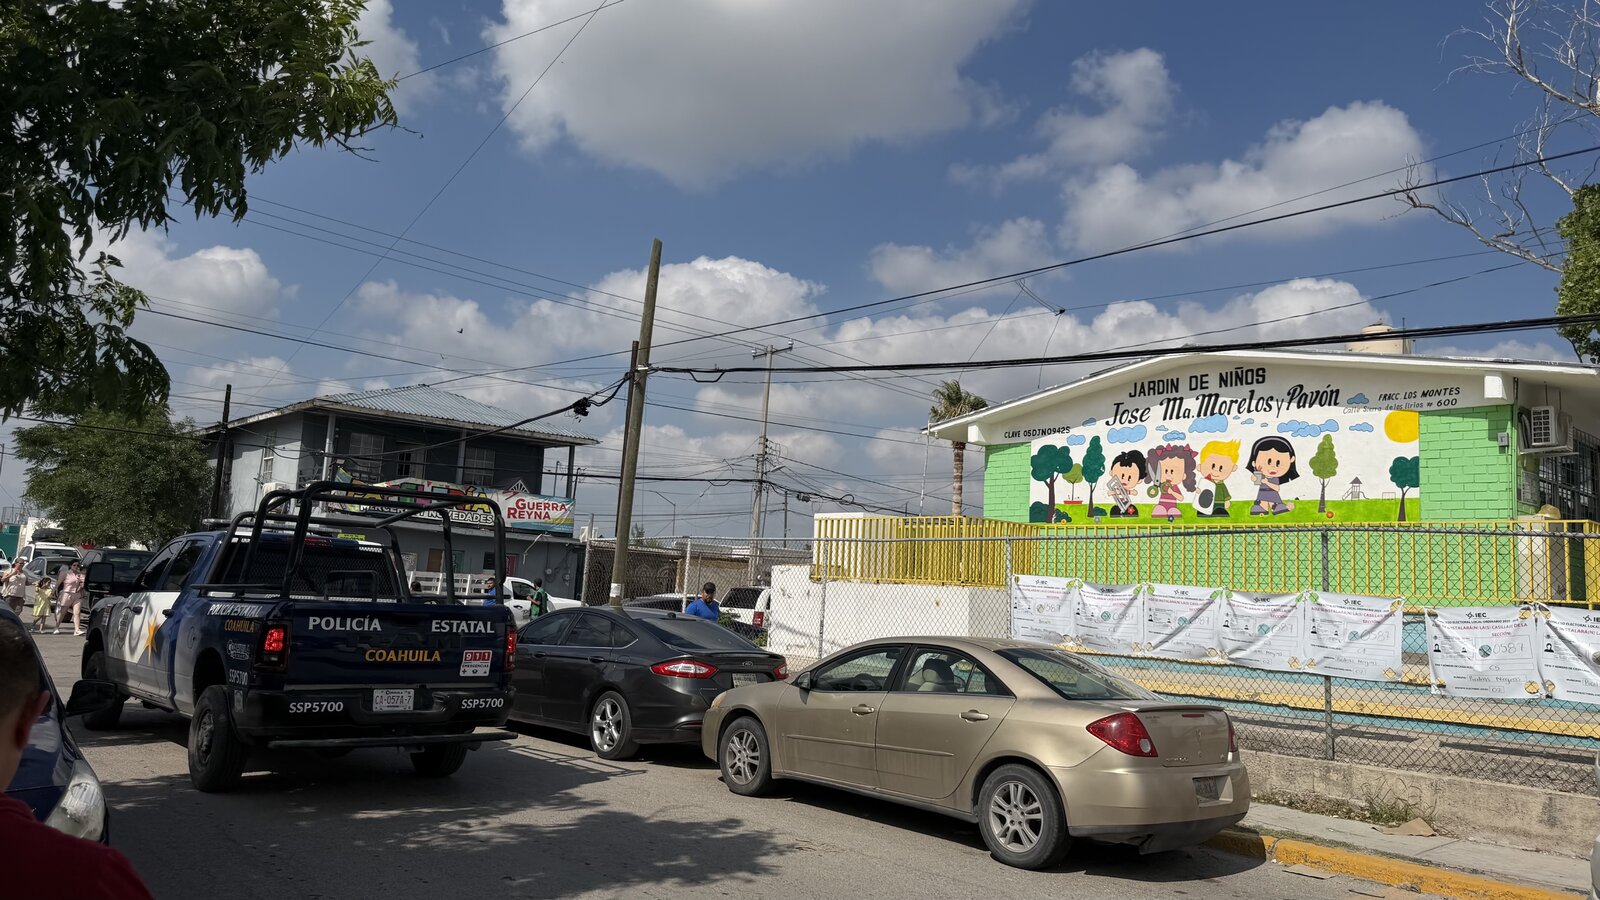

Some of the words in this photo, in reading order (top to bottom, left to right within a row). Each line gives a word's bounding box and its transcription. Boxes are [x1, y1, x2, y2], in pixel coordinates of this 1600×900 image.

[1129, 377, 1179, 398] JARDIN
[1189, 373, 1209, 392] DE
[1219, 366, 1266, 389] NIÑOS
[1403, 391, 1418, 400] LOS
[1421, 387, 1461, 398] MONTES
[1105, 402, 1151, 426] Jose
[1195, 389, 1274, 417] Morelos
[1286, 384, 1340, 411] Pavón
[1437, 398, 1458, 407] 600
[1004, 430, 1021, 439] CLAVE
[515, 498, 567, 511] GUERRA
[507, 507, 551, 520] REYNA
[224, 619, 255, 633] COAHUILA
[308, 615, 382, 632] POLICÍA
[431, 620, 495, 634] ESTATAL
[365, 649, 441, 662] COAHUILA
[465, 652, 489, 661] 911
[289, 701, 344, 713] SSP5700
[461, 698, 504, 709] SSP5700
